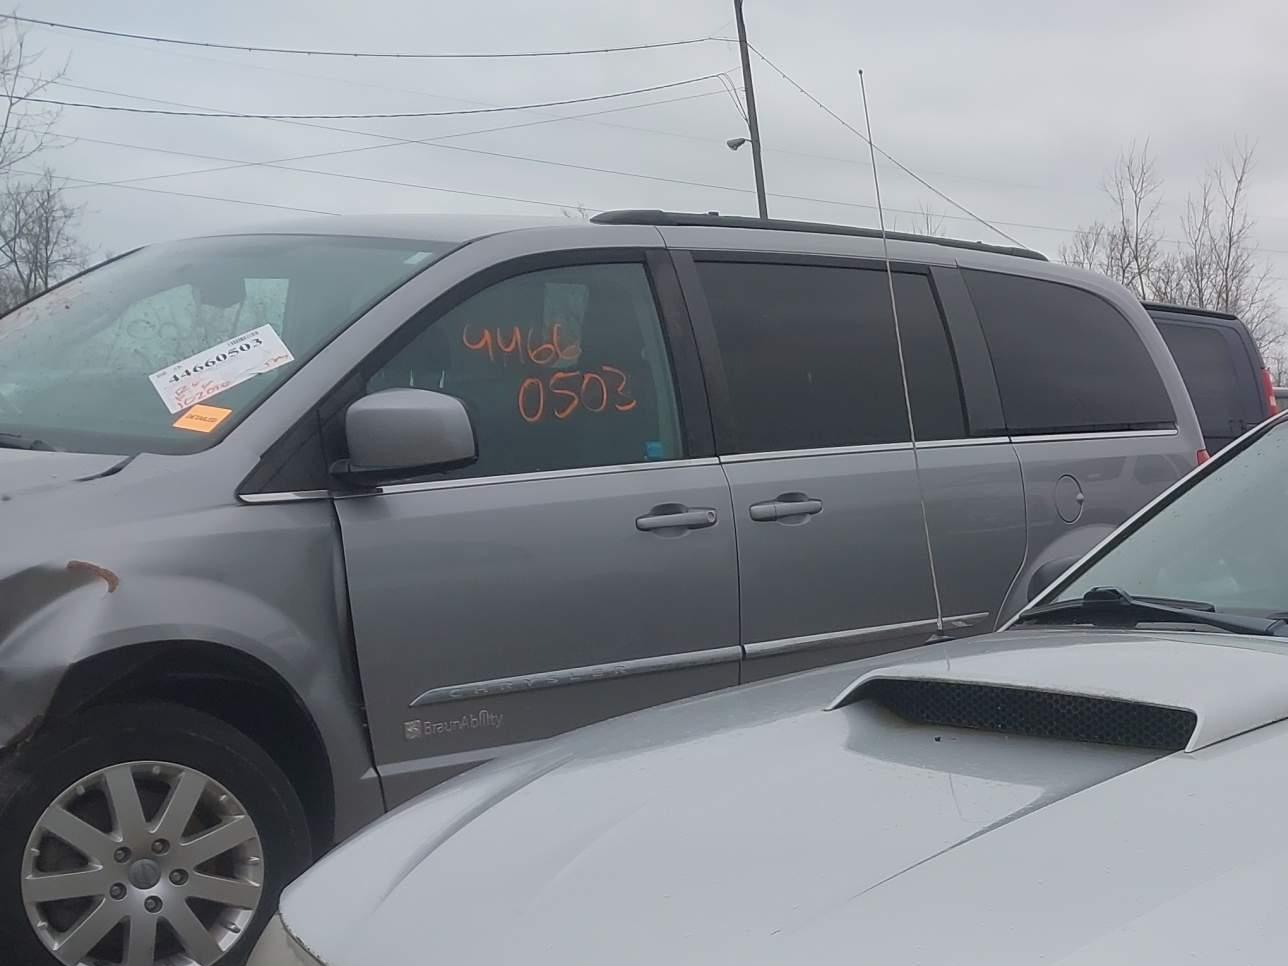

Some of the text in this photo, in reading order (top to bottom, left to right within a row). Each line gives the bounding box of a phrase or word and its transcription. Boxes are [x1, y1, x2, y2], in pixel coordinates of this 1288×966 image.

[168, 337, 263, 384] 44660503
[463, 323, 582, 364] 4466
[518, 365, 637, 422] 0503
[423, 710, 504, 736] BraunAbility
